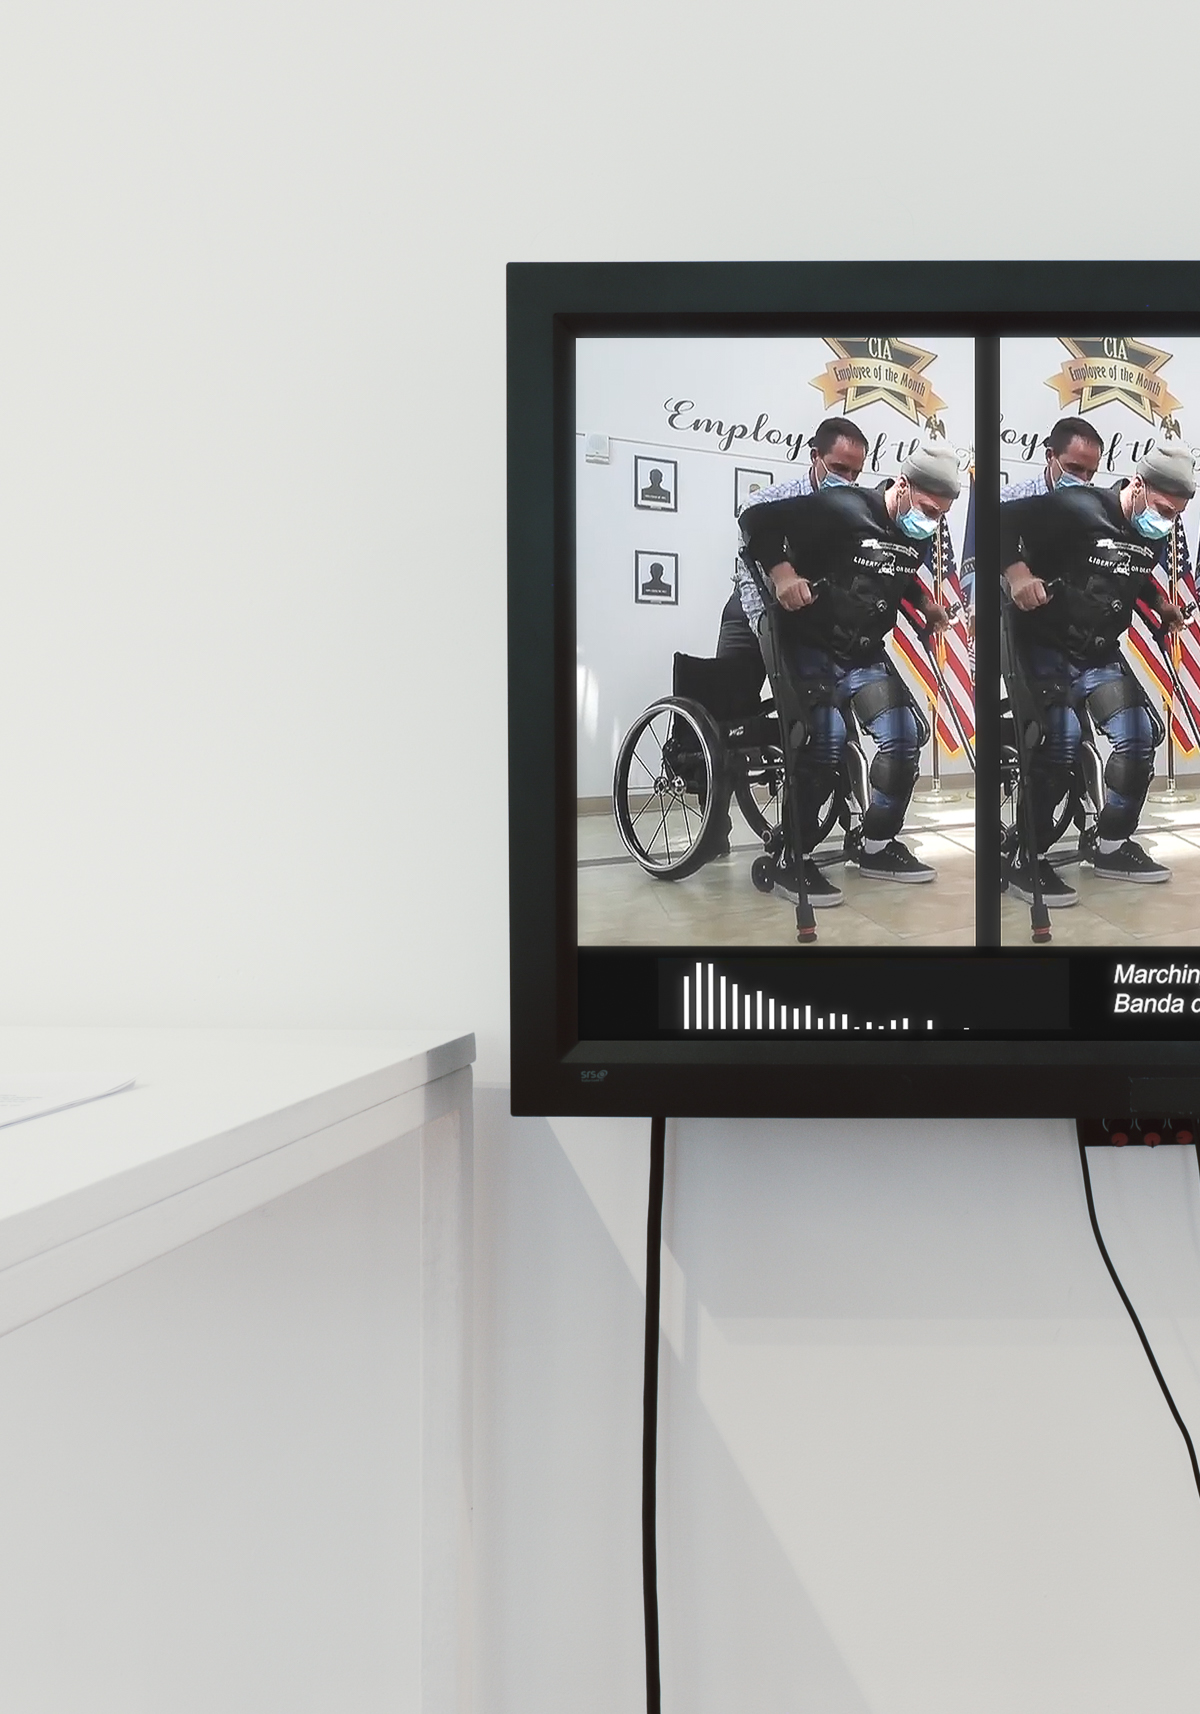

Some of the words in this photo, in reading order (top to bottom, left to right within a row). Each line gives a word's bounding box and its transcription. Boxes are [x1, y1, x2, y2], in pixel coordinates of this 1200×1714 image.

[869, 337, 893, 360] CIA
[1104, 337, 1128, 360] CIA
[833, 364, 871, 382] Employee
[874, 365, 882, 381] of
[885, 367, 898, 382] the
[900, 372, 926, 397] Month
[1068, 363, 1106, 381] Employee
[1109, 364, 1117, 381] of
[1120, 367, 1133, 382] the
[1136, 372, 1161, 396] Month
[1114, 993, 1184, 1013] Banda
